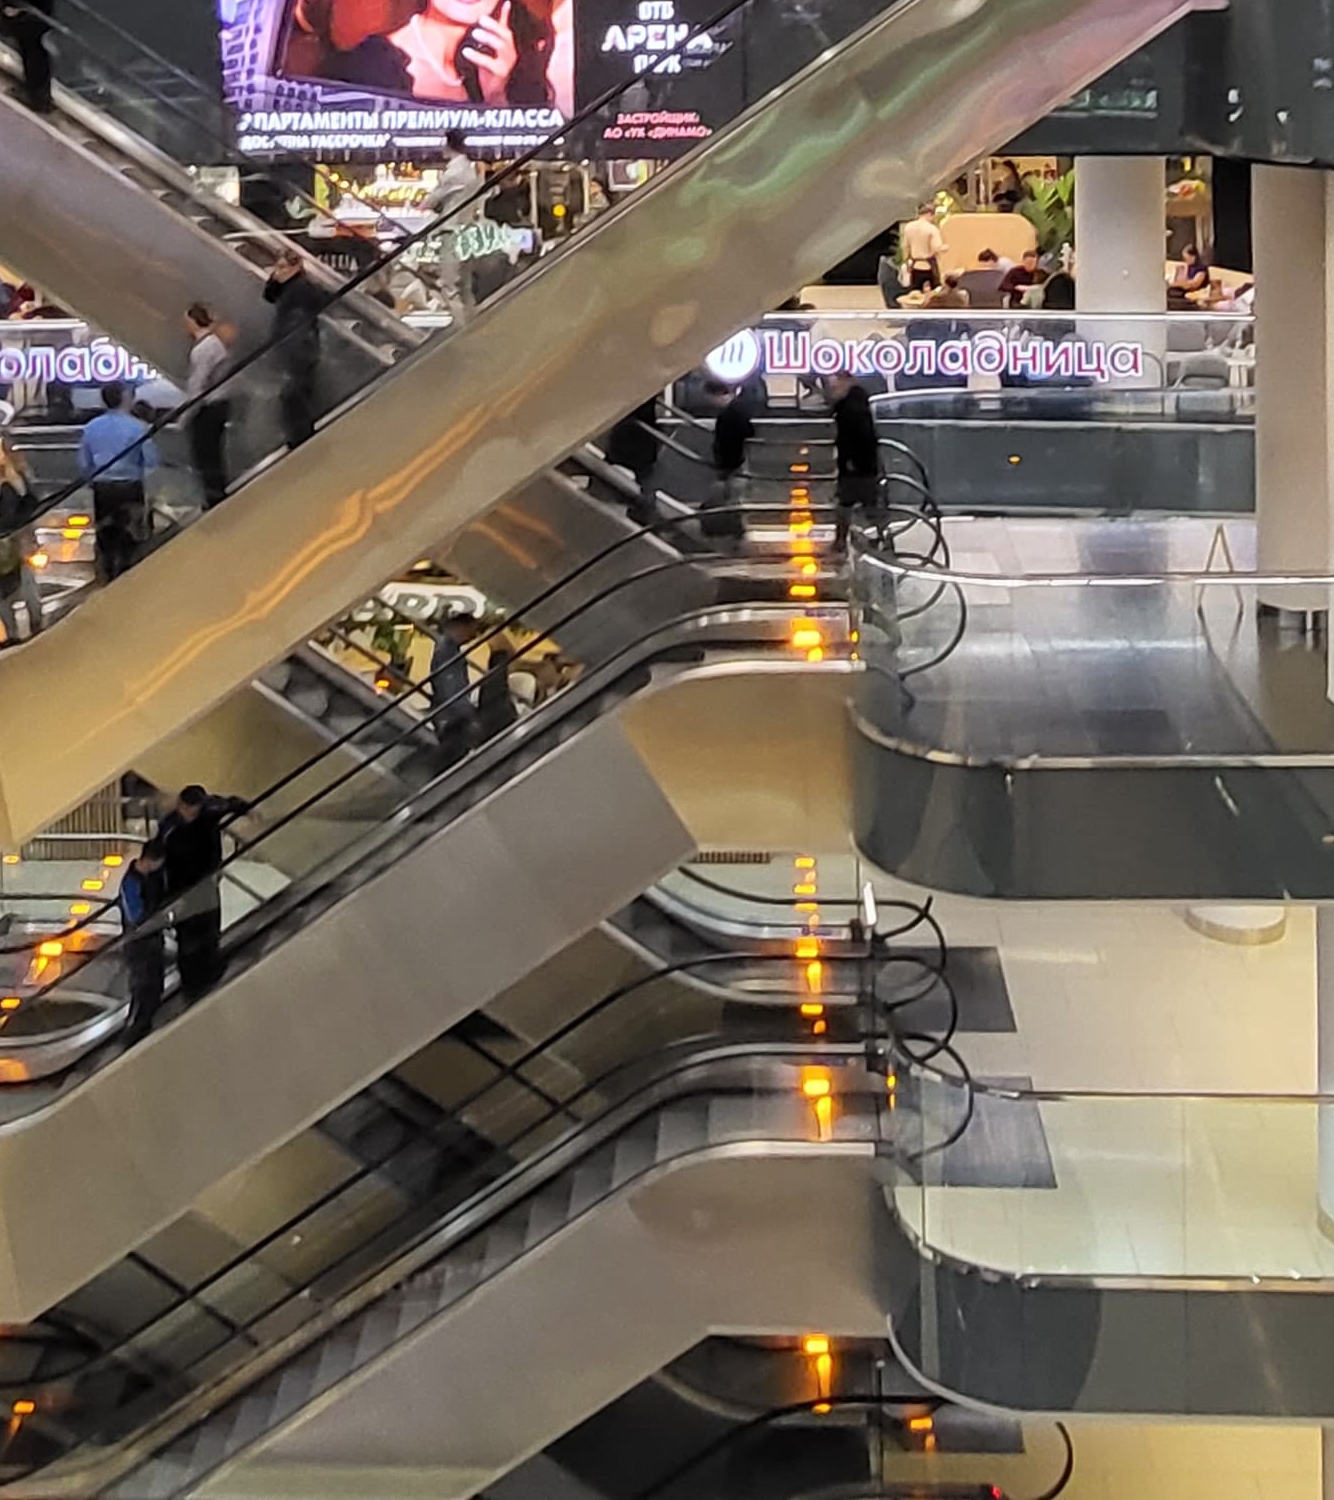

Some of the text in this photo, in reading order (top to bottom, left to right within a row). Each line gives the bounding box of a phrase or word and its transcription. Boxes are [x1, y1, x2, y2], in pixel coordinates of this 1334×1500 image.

[638, 0, 675, 20] ВТБ
[382, 108, 565, 130] ПРЕМИУМ-КЛАССА
[765, 329, 1144, 383] Шоколадница
